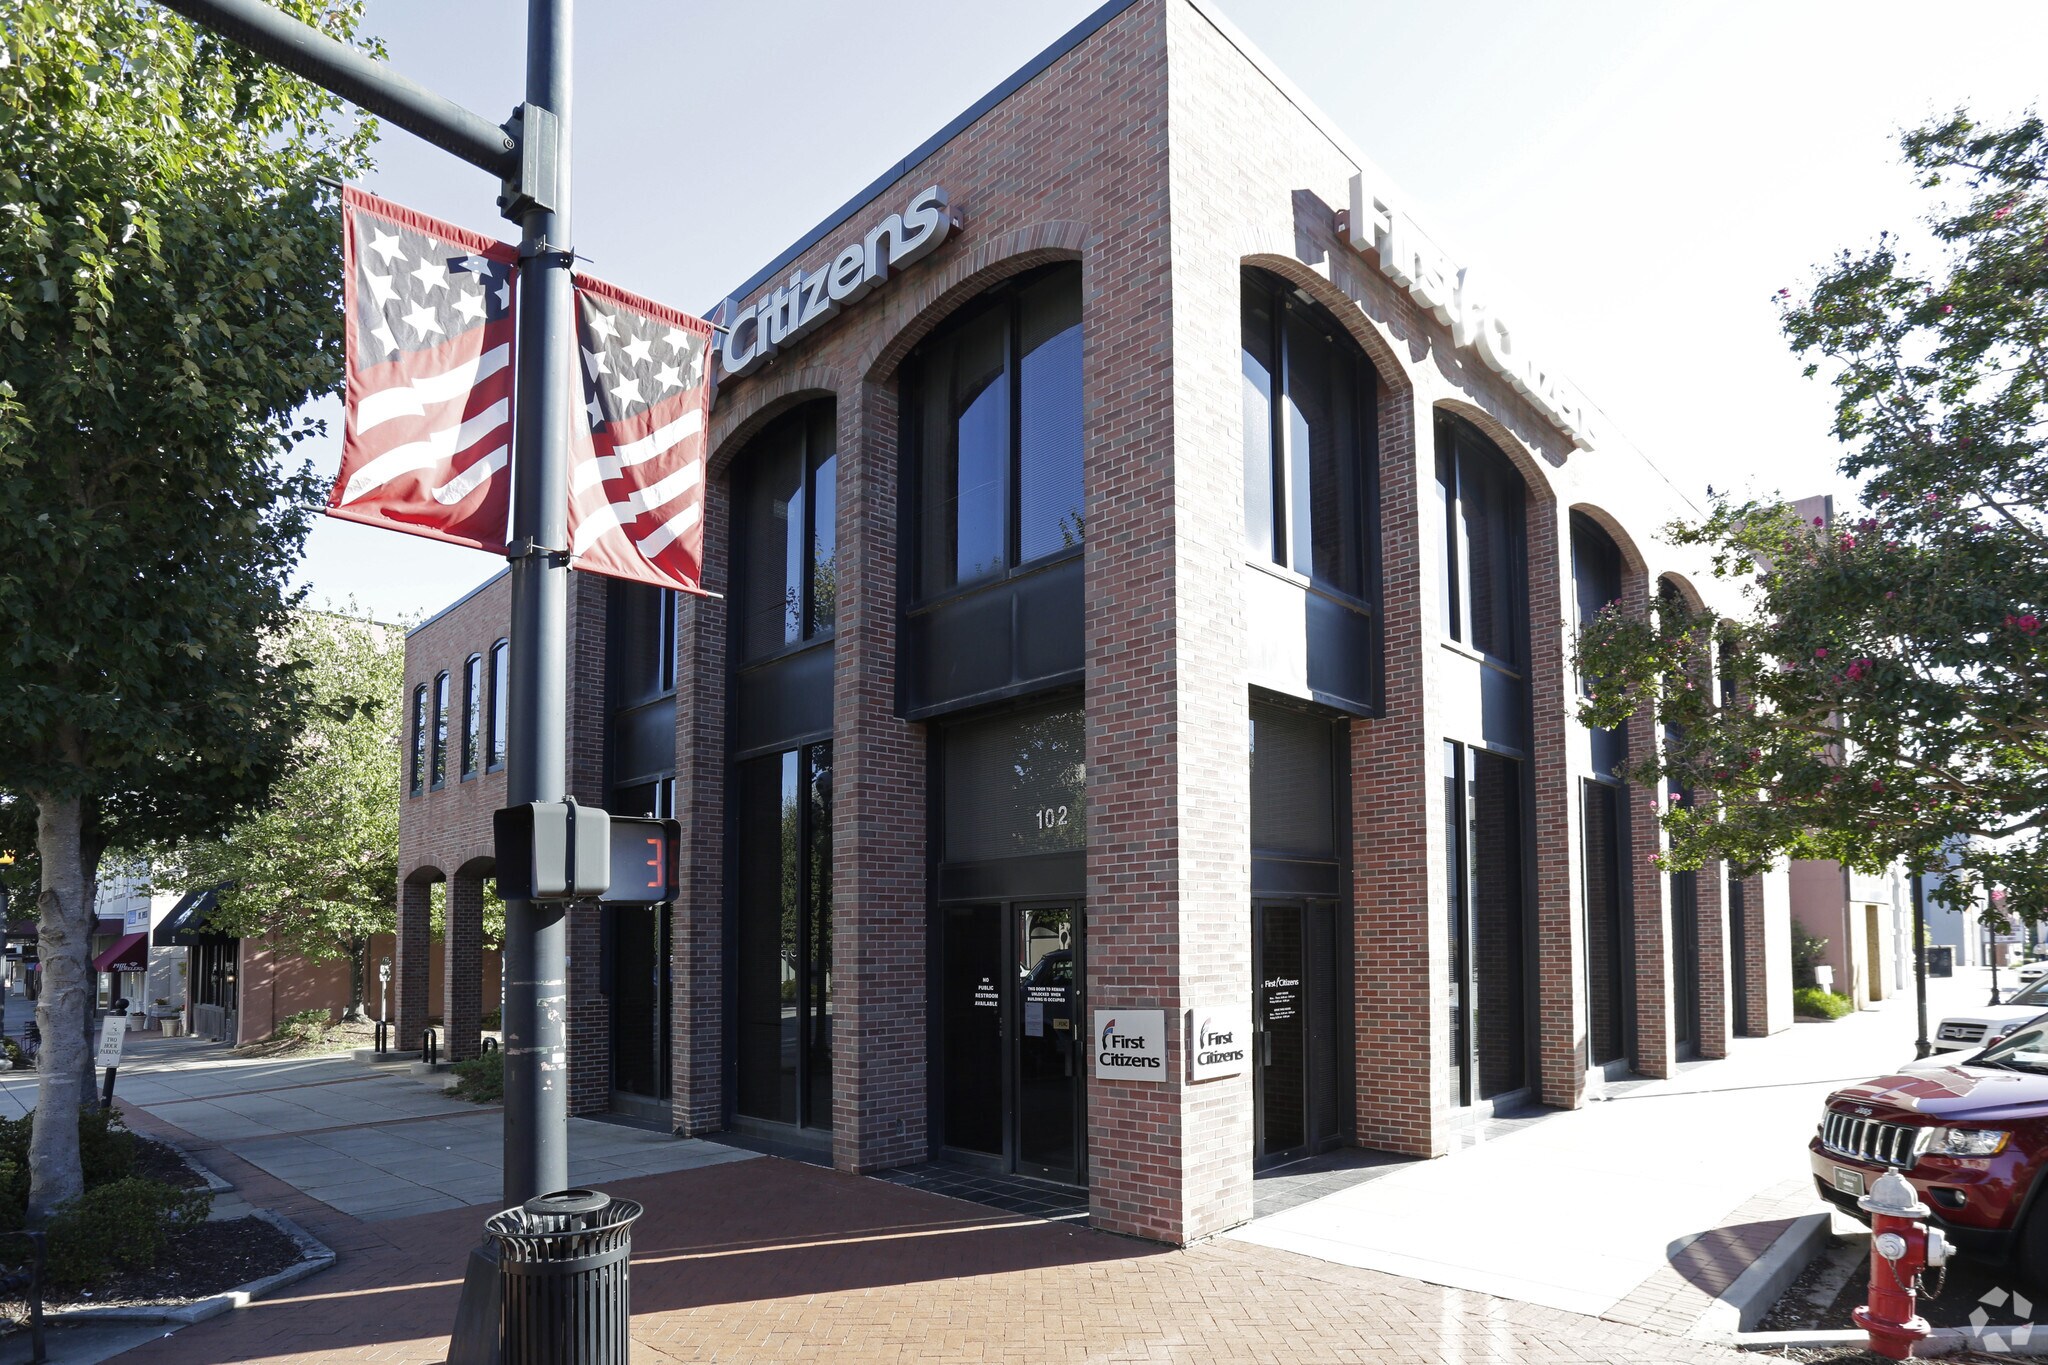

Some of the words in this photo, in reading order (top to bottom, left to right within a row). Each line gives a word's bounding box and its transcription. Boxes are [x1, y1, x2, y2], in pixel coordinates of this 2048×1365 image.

[721, 184, 950, 378] Citizens
[1036, 805, 1068, 829] 102
[646, 838, 663, 888] 3
[1264, 980, 1276, 988] First
[1279, 978, 1300, 987] Citizens
[1111, 1034, 1145, 1049] First
[1208, 1031, 1234, 1047] First
[1099, 1052, 1161, 1068] Citizens
[1197, 1050, 1244, 1066] Citizens
